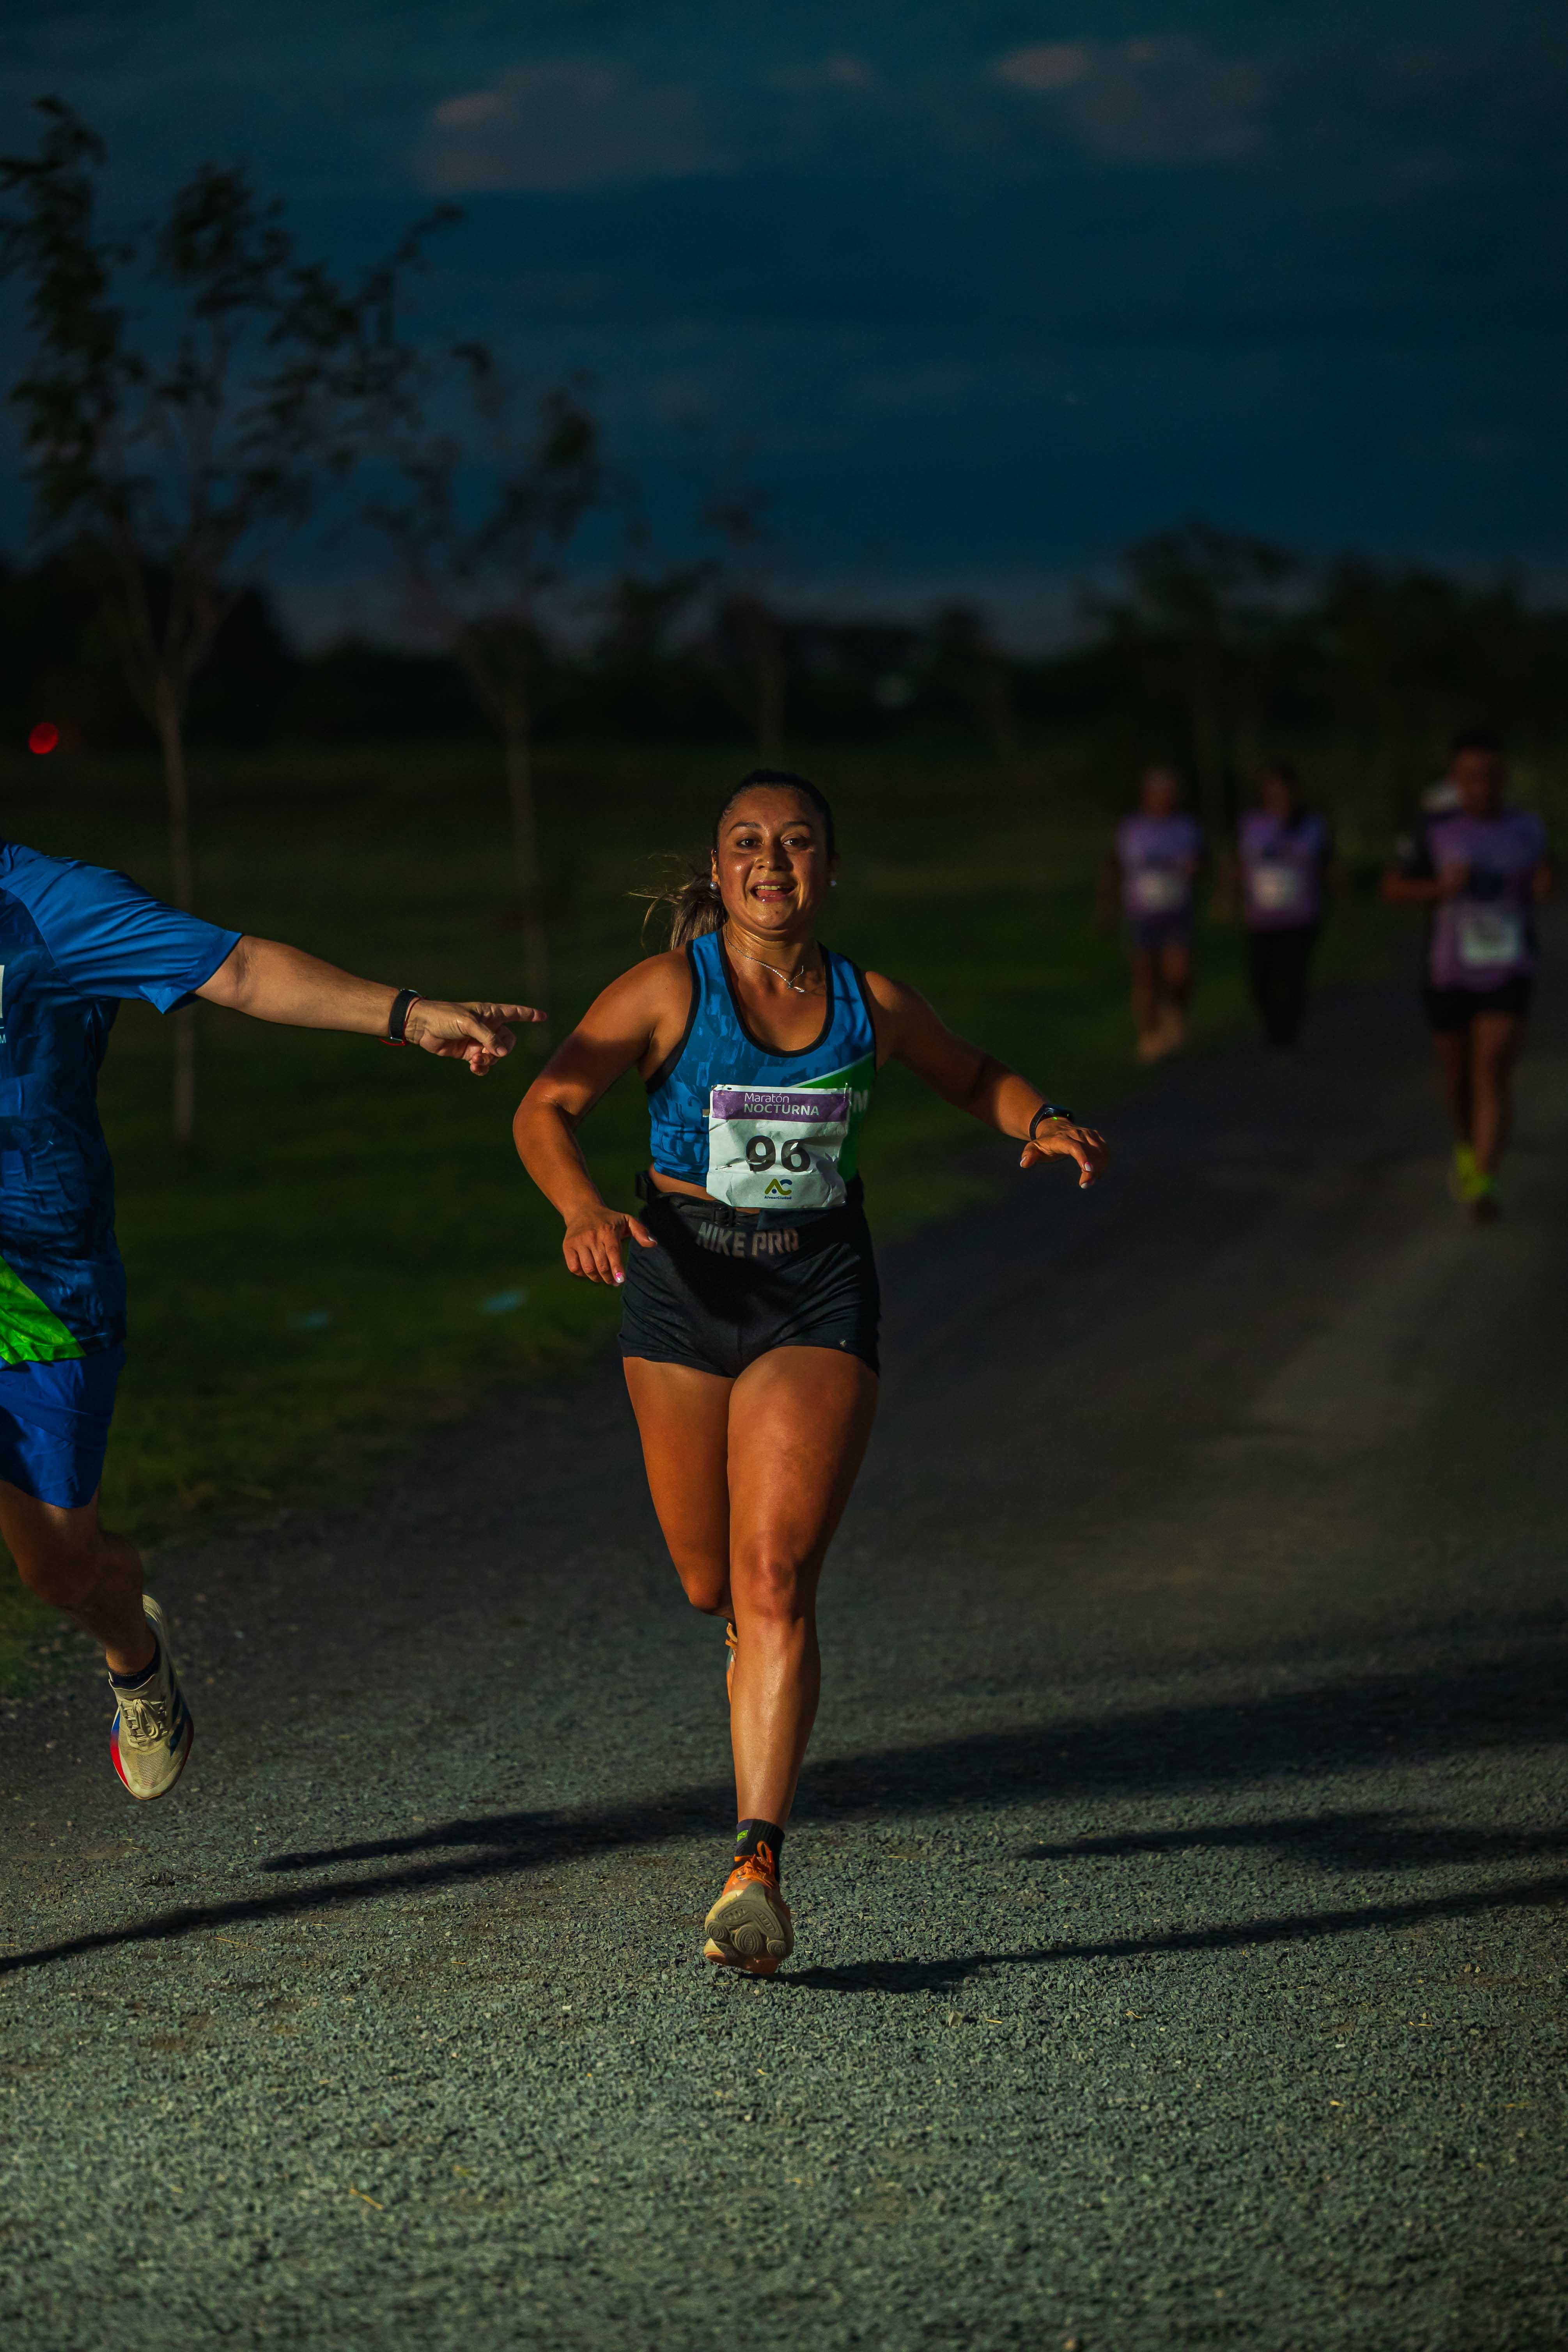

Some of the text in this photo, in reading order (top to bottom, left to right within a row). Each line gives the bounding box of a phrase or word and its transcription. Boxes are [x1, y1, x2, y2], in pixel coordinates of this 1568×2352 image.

[744, 1093, 790, 1103] Maratón
[744, 1103, 819, 1116] NOCTURNA
[745, 1135, 811, 1172] 96
[696, 1222, 799, 1258] NIKE PRO
